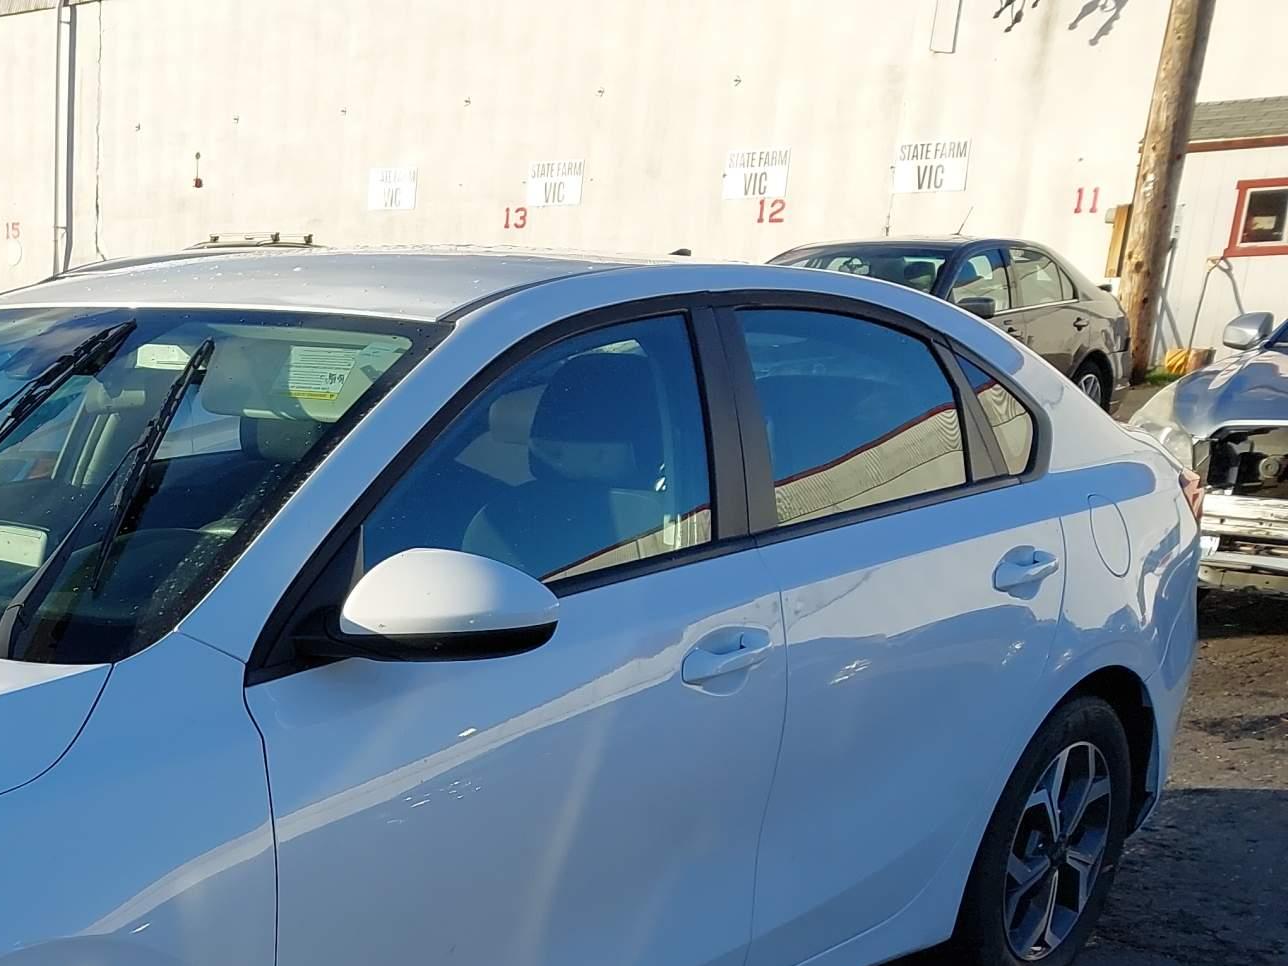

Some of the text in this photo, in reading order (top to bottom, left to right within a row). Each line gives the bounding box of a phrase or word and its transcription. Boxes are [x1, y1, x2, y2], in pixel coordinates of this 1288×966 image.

[728, 149, 788, 169] STATE FARM
[899, 141, 968, 161] STATE FARM
[531, 161, 583, 178] STATE FARM
[916, 164, 944, 190] VIC
[543, 181, 565, 203] VIC
[743, 171, 768, 196] VIC
[383, 187, 401, 208] VIC
[1074, 186, 1100, 213] 11
[503, 206, 528, 229] 13
[757, 199, 786, 223] 12
[5, 222, 21, 240] 15
